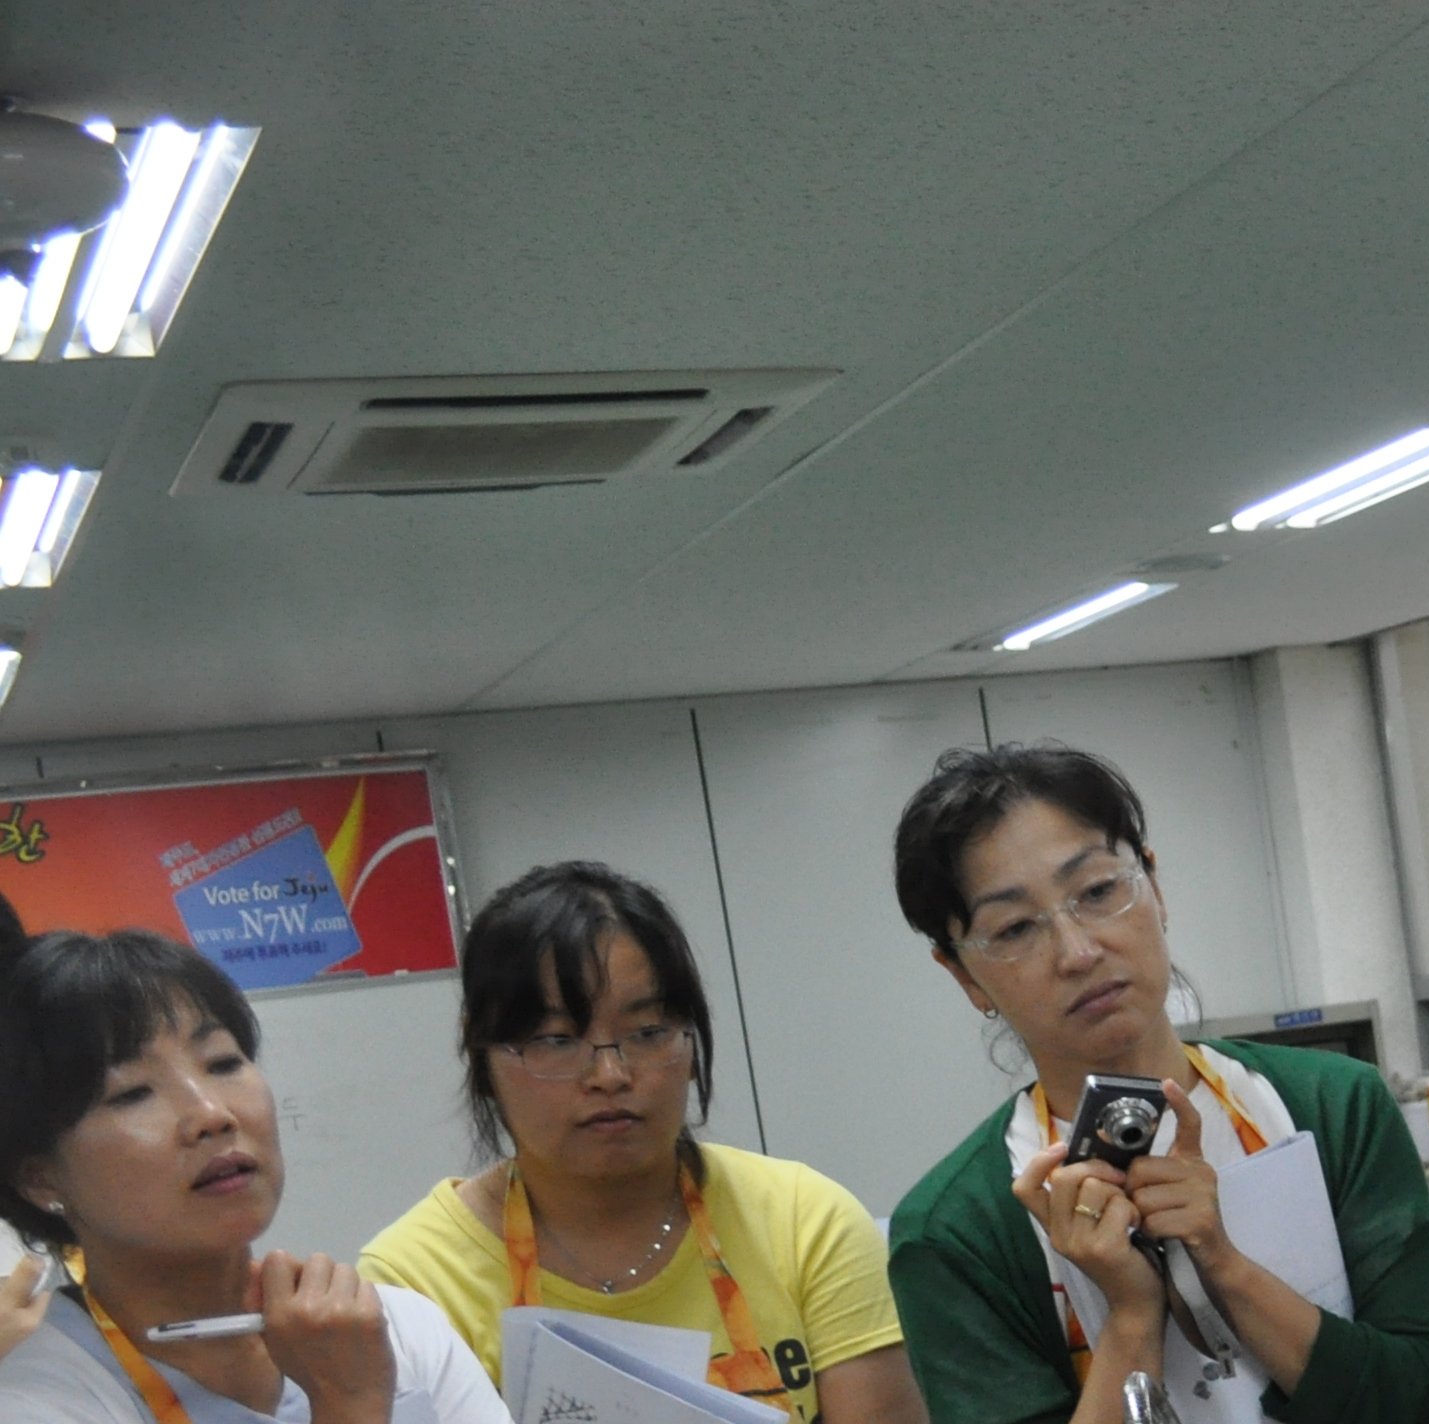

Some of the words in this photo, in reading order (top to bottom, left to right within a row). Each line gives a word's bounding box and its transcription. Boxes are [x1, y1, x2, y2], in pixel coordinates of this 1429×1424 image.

[203, 885, 249, 906] Vote
[252, 880, 280, 900] for
[283, 876, 329, 903] Jeju
